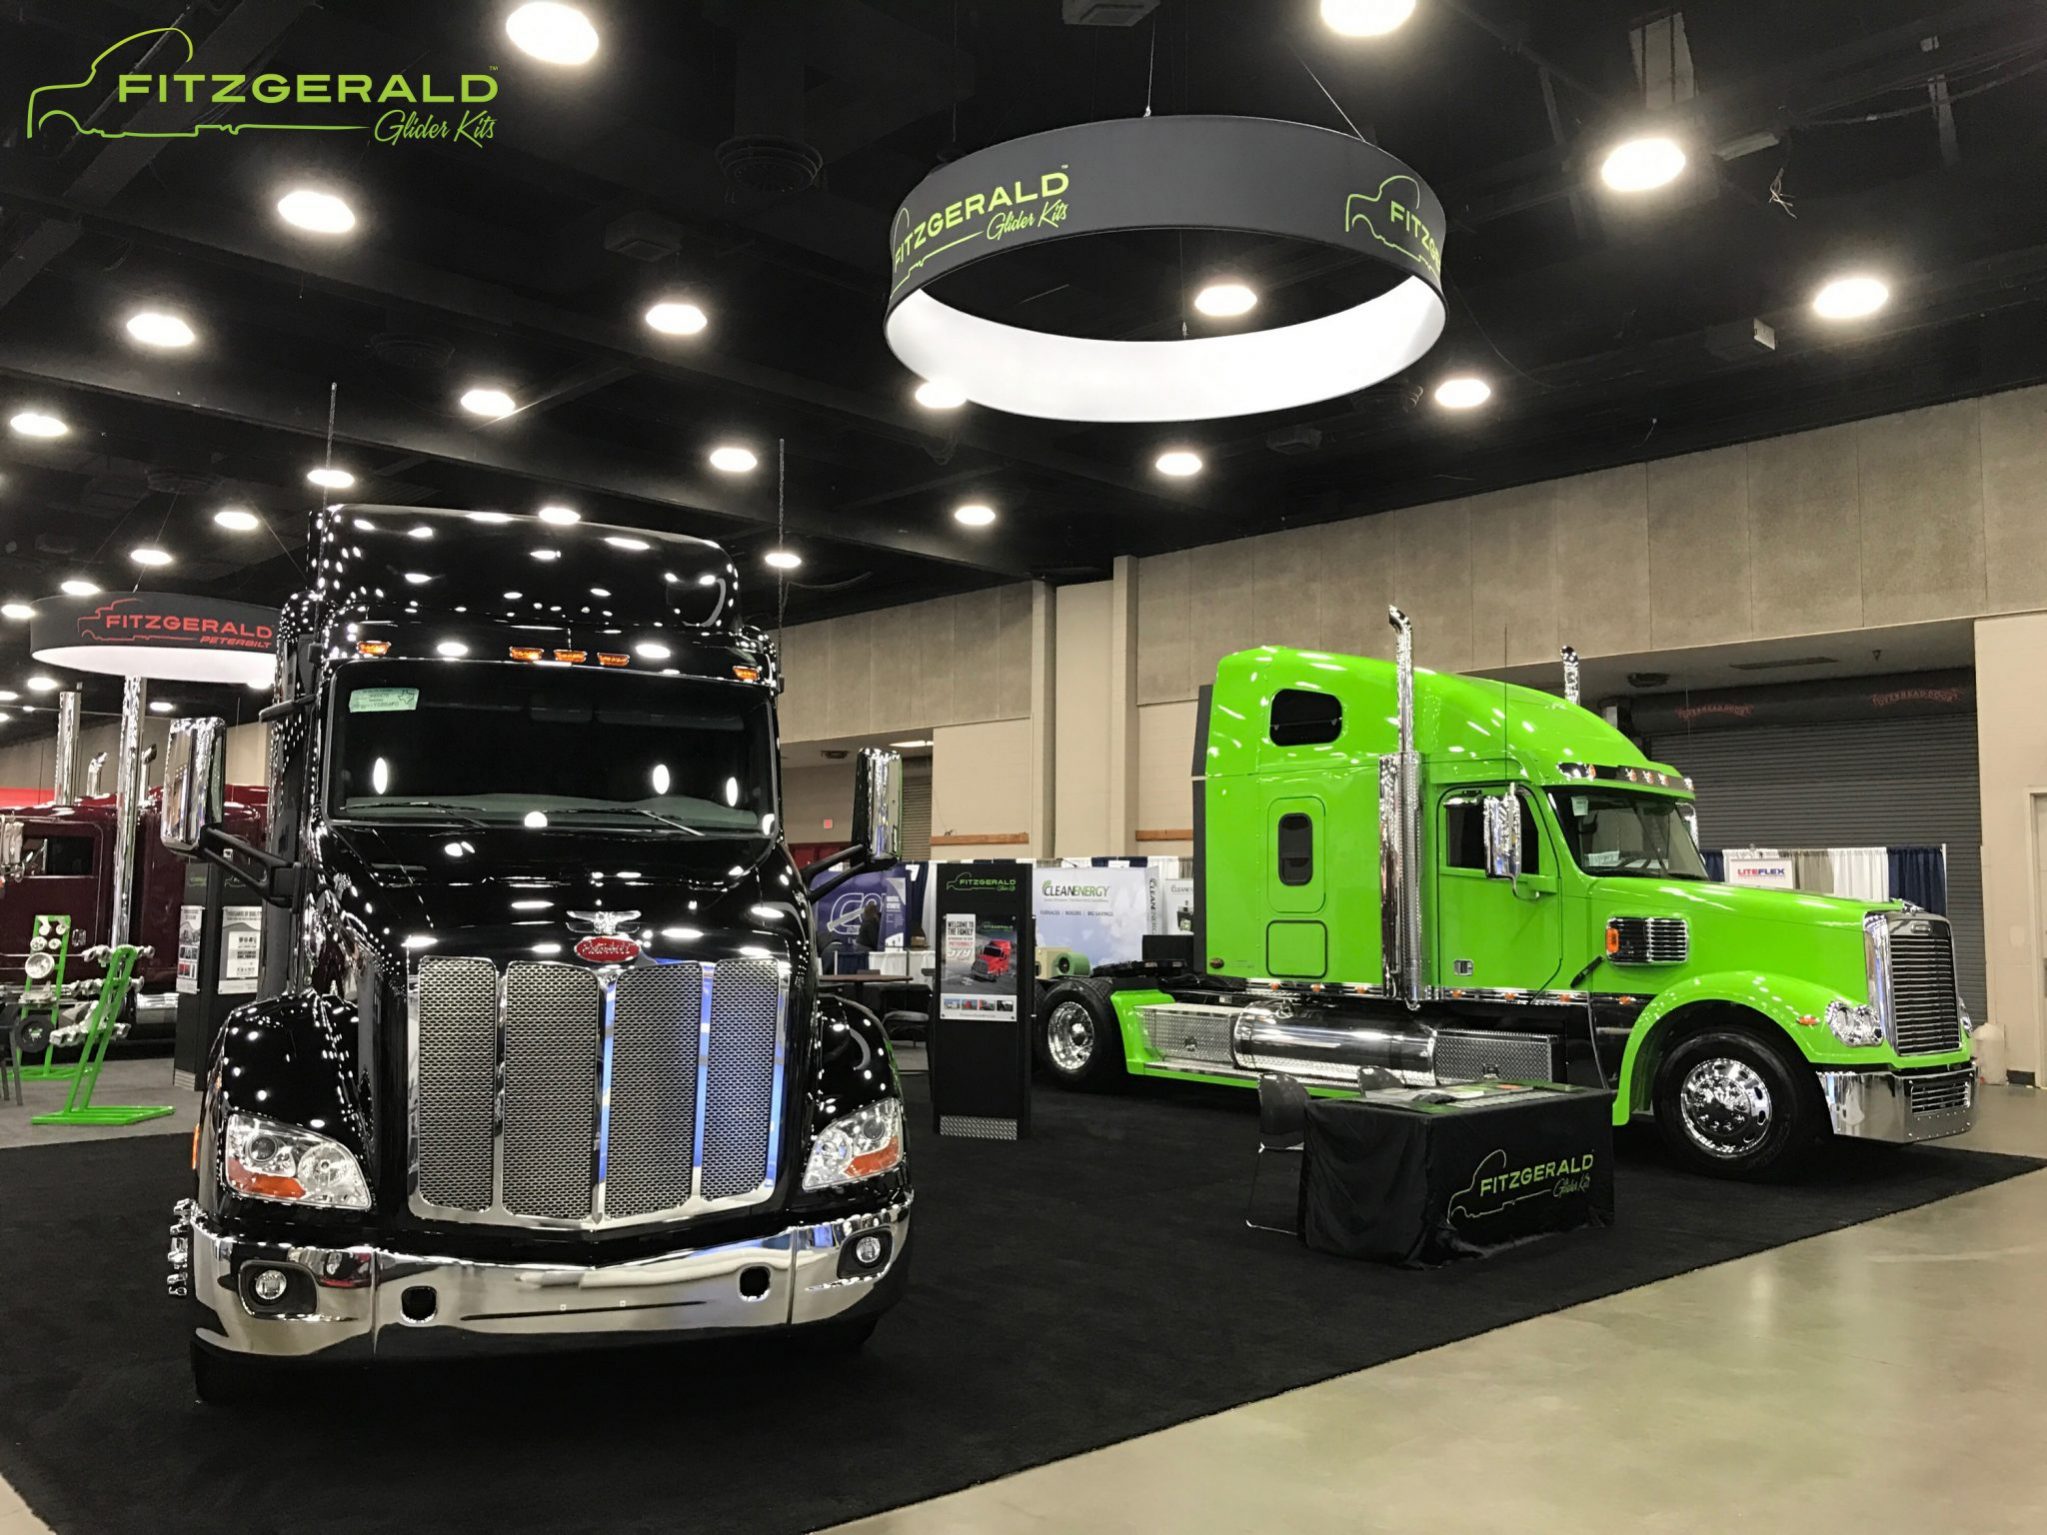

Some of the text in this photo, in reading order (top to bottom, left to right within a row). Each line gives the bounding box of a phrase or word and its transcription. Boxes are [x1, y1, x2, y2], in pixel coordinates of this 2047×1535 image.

[895, 172, 1069, 265] FITZGERALD
[986, 199, 1069, 241] Glider Kits
[106, 614, 273, 639] FITZGERALD
[200, 635, 272, 649] PETERBILT
[959, 878, 1017, 886] FITZGERALD
[1737, 868, 1785, 877] LITEFLEX
[1480, 1154, 1594, 1197] FITZGERALD
